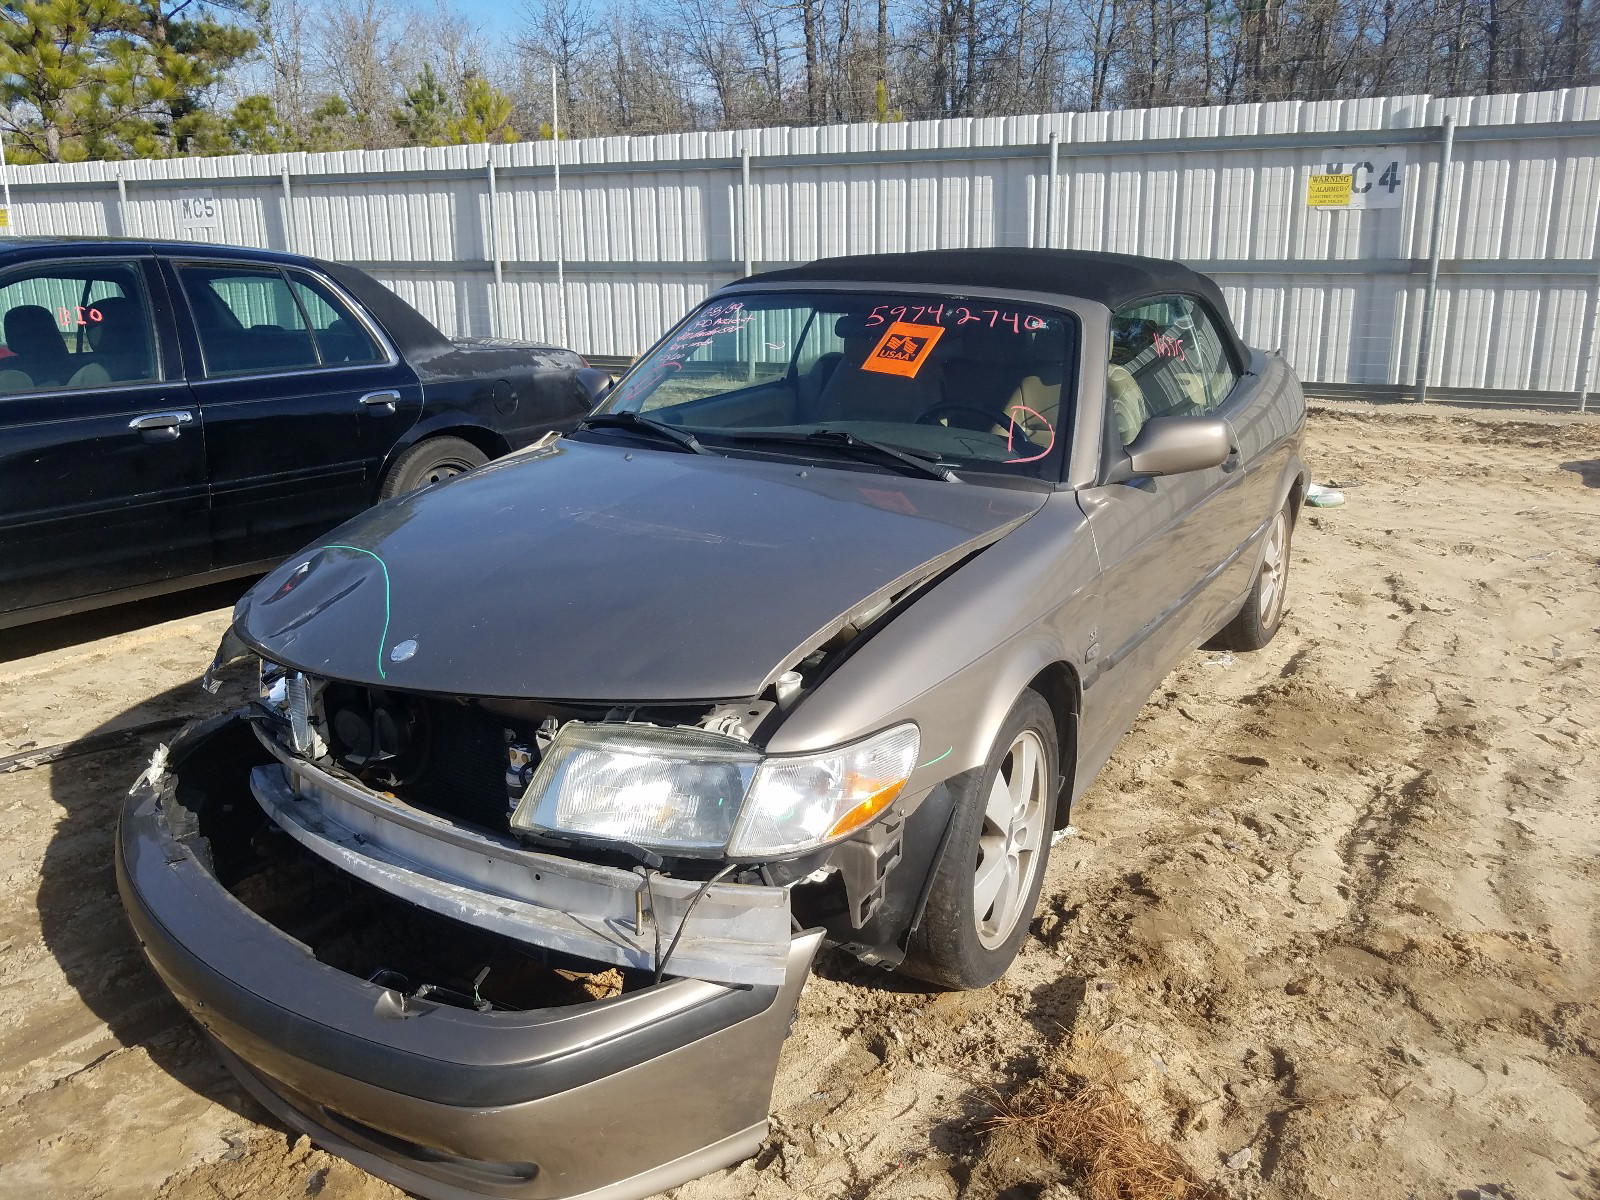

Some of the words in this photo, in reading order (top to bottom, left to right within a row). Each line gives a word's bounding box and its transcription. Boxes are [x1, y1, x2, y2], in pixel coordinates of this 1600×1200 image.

[1312, 175, 1349, 184] WARNING
[182, 197, 215, 219] MC5
[879, 349, 911, 361] USAA
